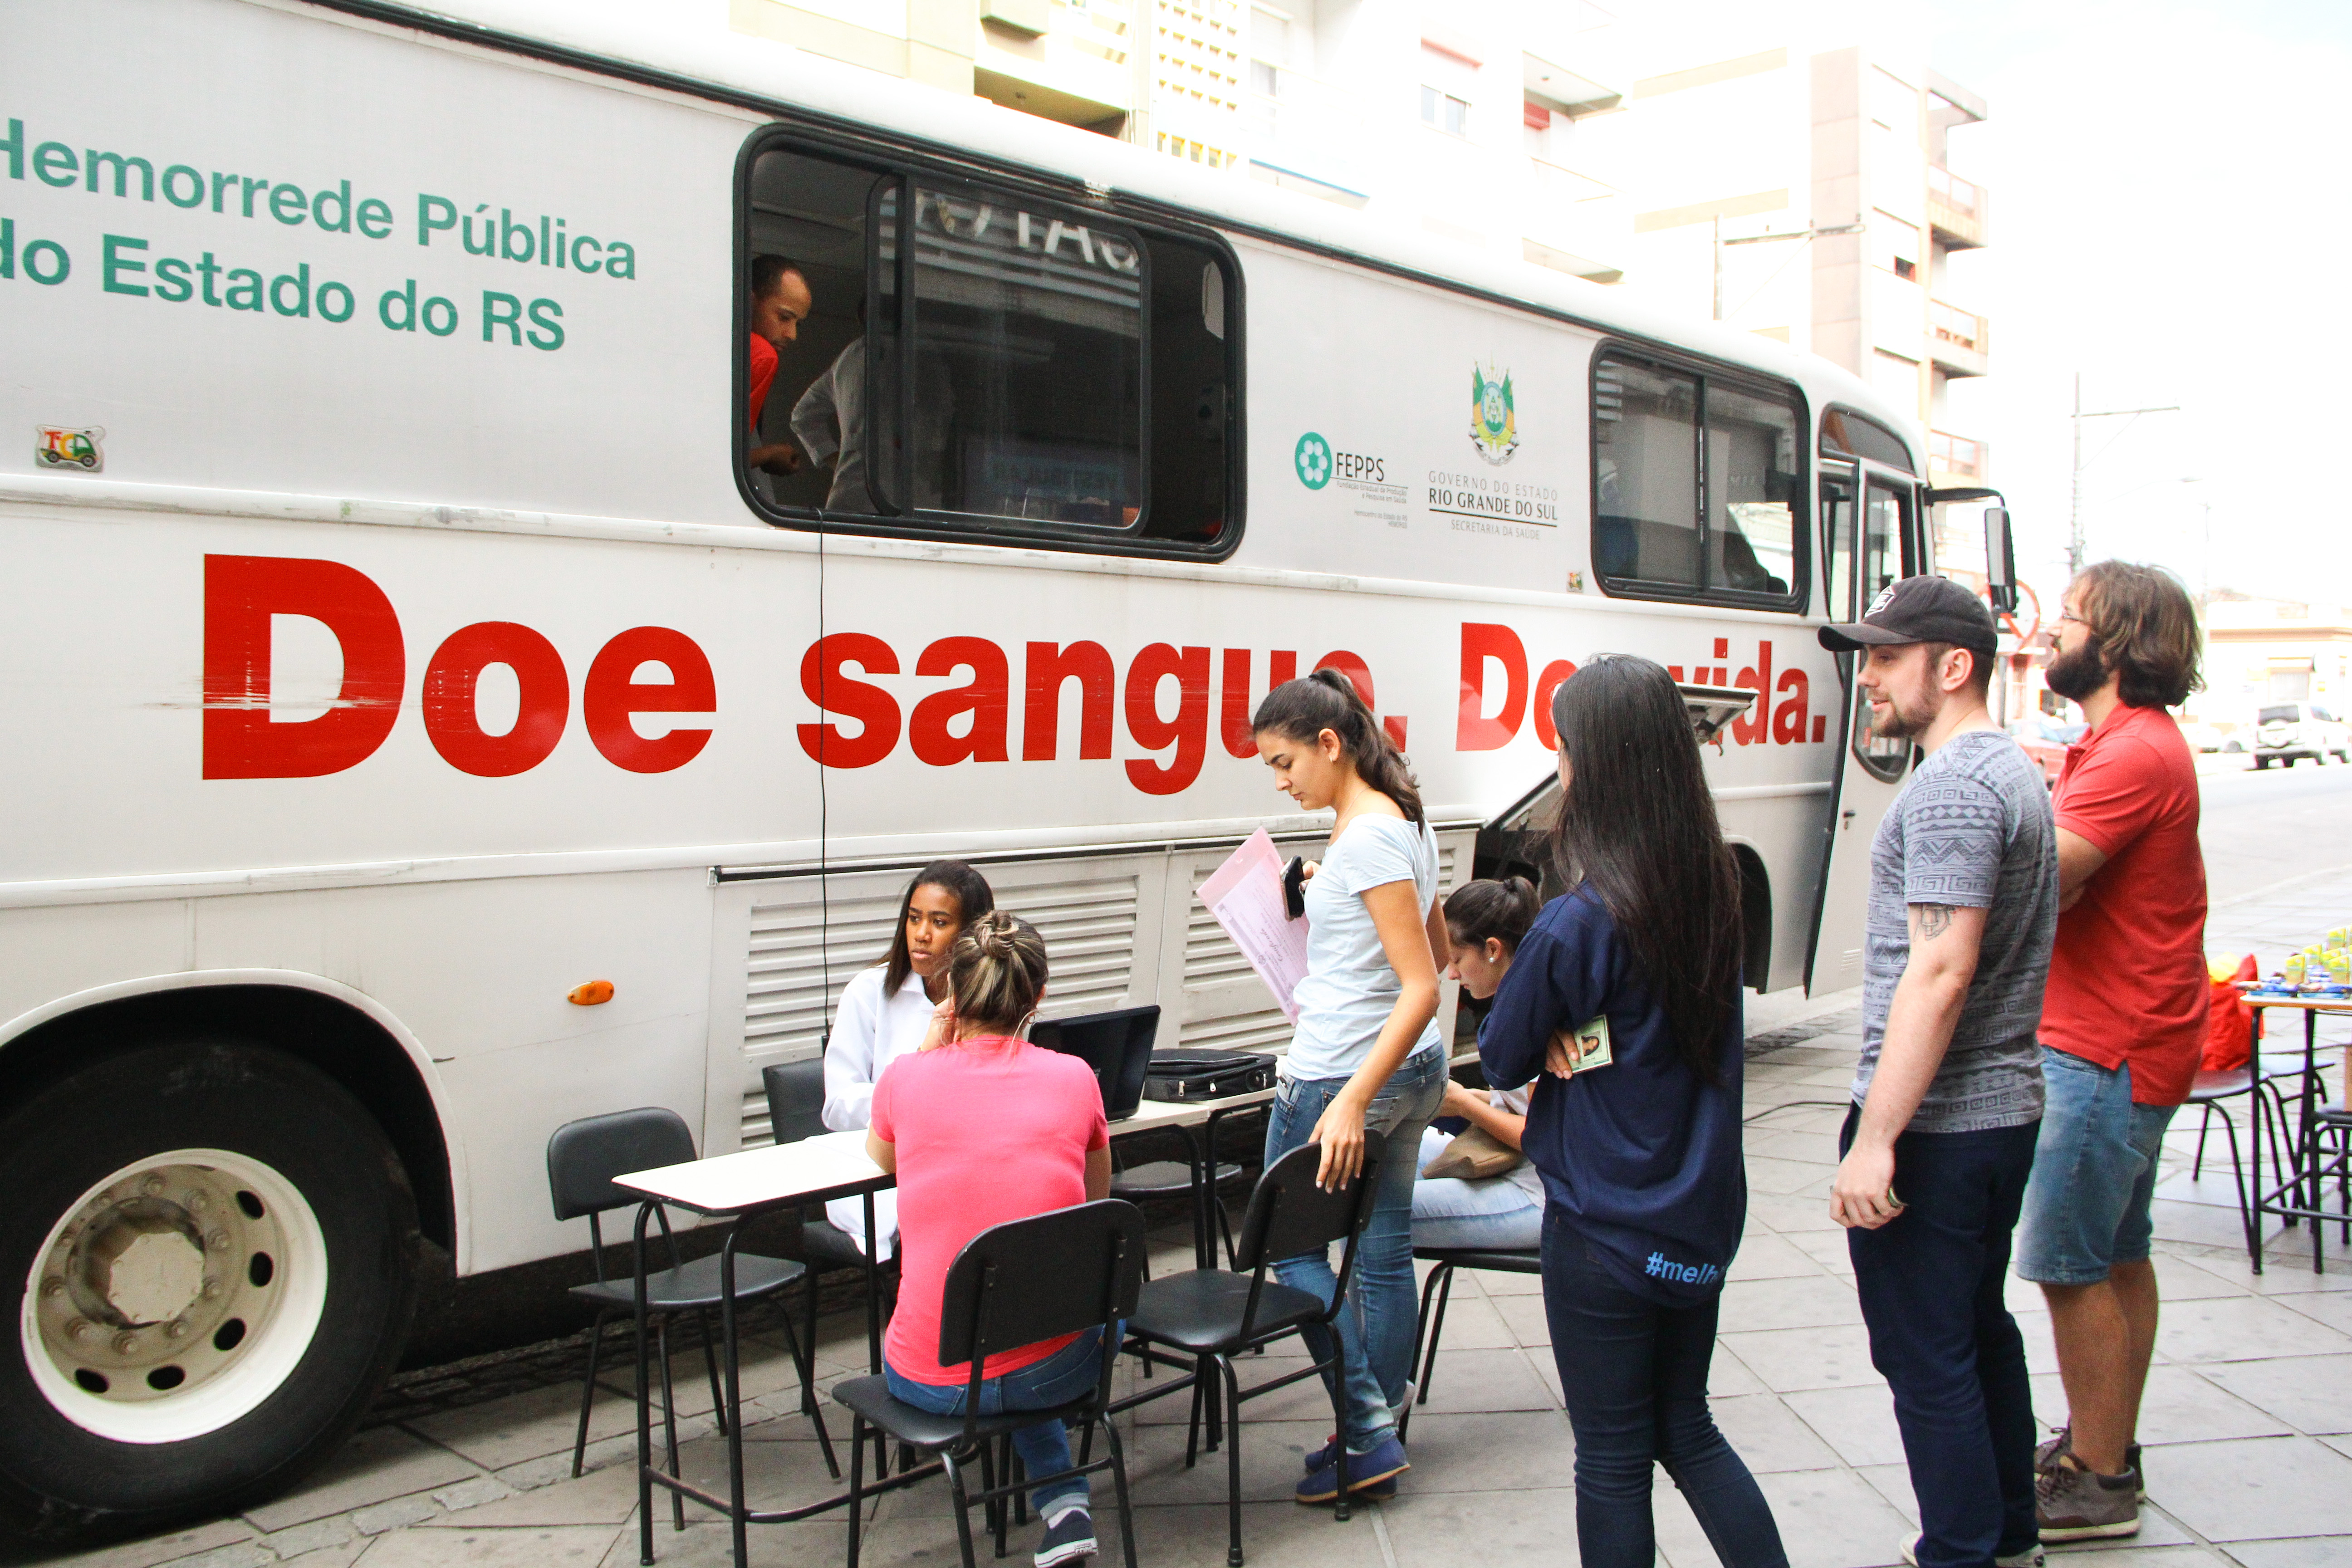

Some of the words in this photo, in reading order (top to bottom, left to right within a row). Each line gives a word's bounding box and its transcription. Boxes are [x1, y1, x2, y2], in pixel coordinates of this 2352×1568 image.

[418, 192, 636, 280] Pública
[102, 232, 355, 323] Estado
[378, 278, 458, 337] do
[482, 289, 564, 351] RS
[1337, 452, 1384, 482] FEPPS
[1429, 470, 1487, 490] GOVERNO
[1494, 480, 1509, 494] DO
[1515, 483, 1558, 501] ESTADO
[1429, 488, 1452, 505] RIO
[1457, 491, 1511, 514] GRANDE
[1516, 500, 1533, 517] DO
[1537, 503, 1558, 520] SUL
[1450, 519, 1500, 535] SECRETARIA
[1502, 525, 1513, 537] DA
[1515, 526, 1540, 540] SAÚDE
[203, 554, 716, 780] Doe
[1455, 622, 1579, 751] Do
